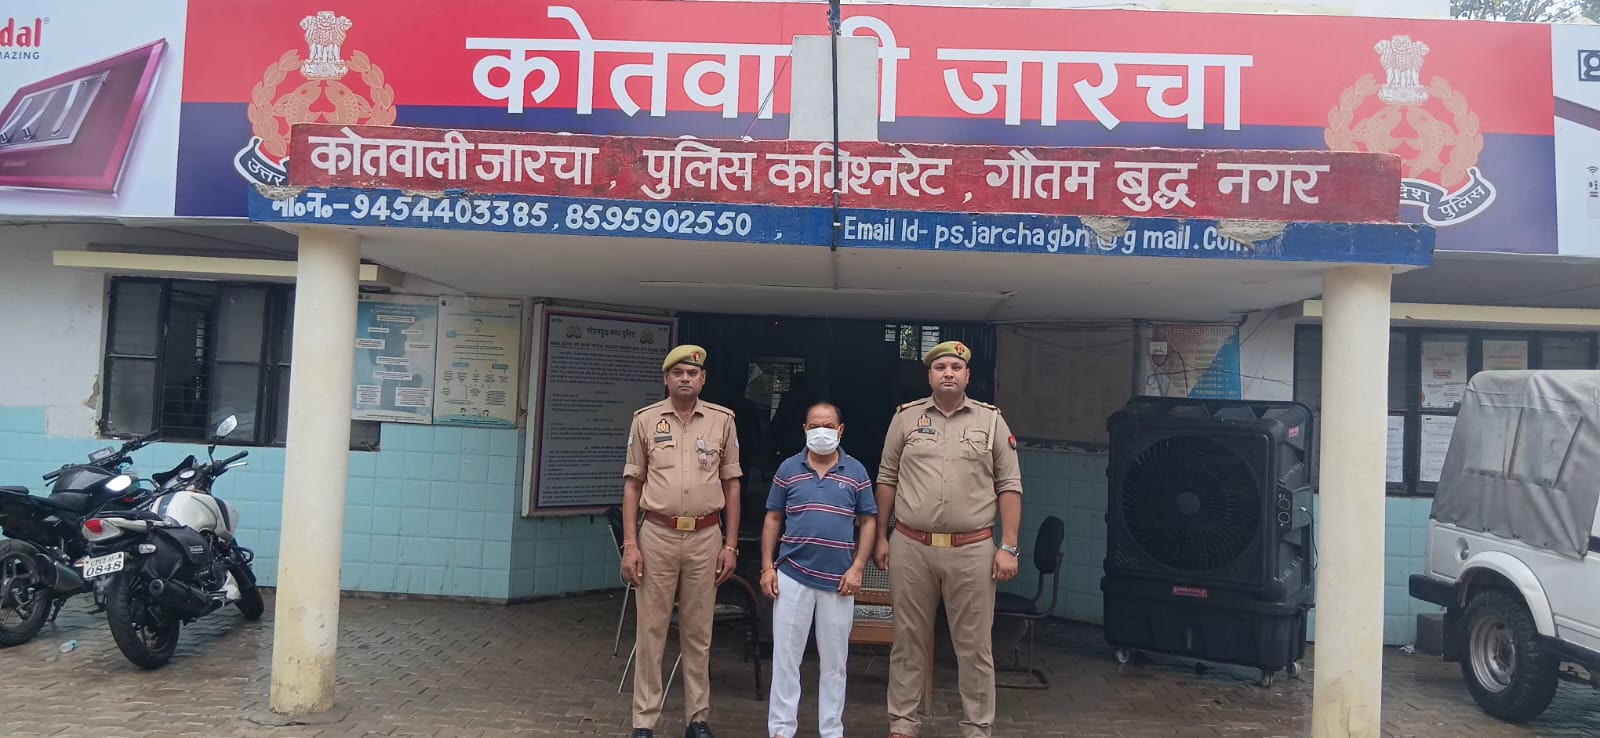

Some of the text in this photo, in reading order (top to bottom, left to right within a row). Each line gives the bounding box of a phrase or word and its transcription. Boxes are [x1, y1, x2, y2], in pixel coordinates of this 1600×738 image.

[0, 51, 40, 60] AZING
[465, 5, 1253, 130] कोतवाी जारचा
[248, 157, 285, 186] उत्तर
[308, 126, 475, 180] कोतवाली
[475, 143, 599, 185] जारचा
[640, 140, 758, 200] पुलिस
[984, 148, 1100, 200] गौतम
[1114, 161, 1197, 212] बुद्ध
[1217, 163, 1330, 204] नगर
[1438, 184, 1485, 219] पुलिस
[844, 215, 894, 241] Email
[86, 560, 122, 577] 0848
